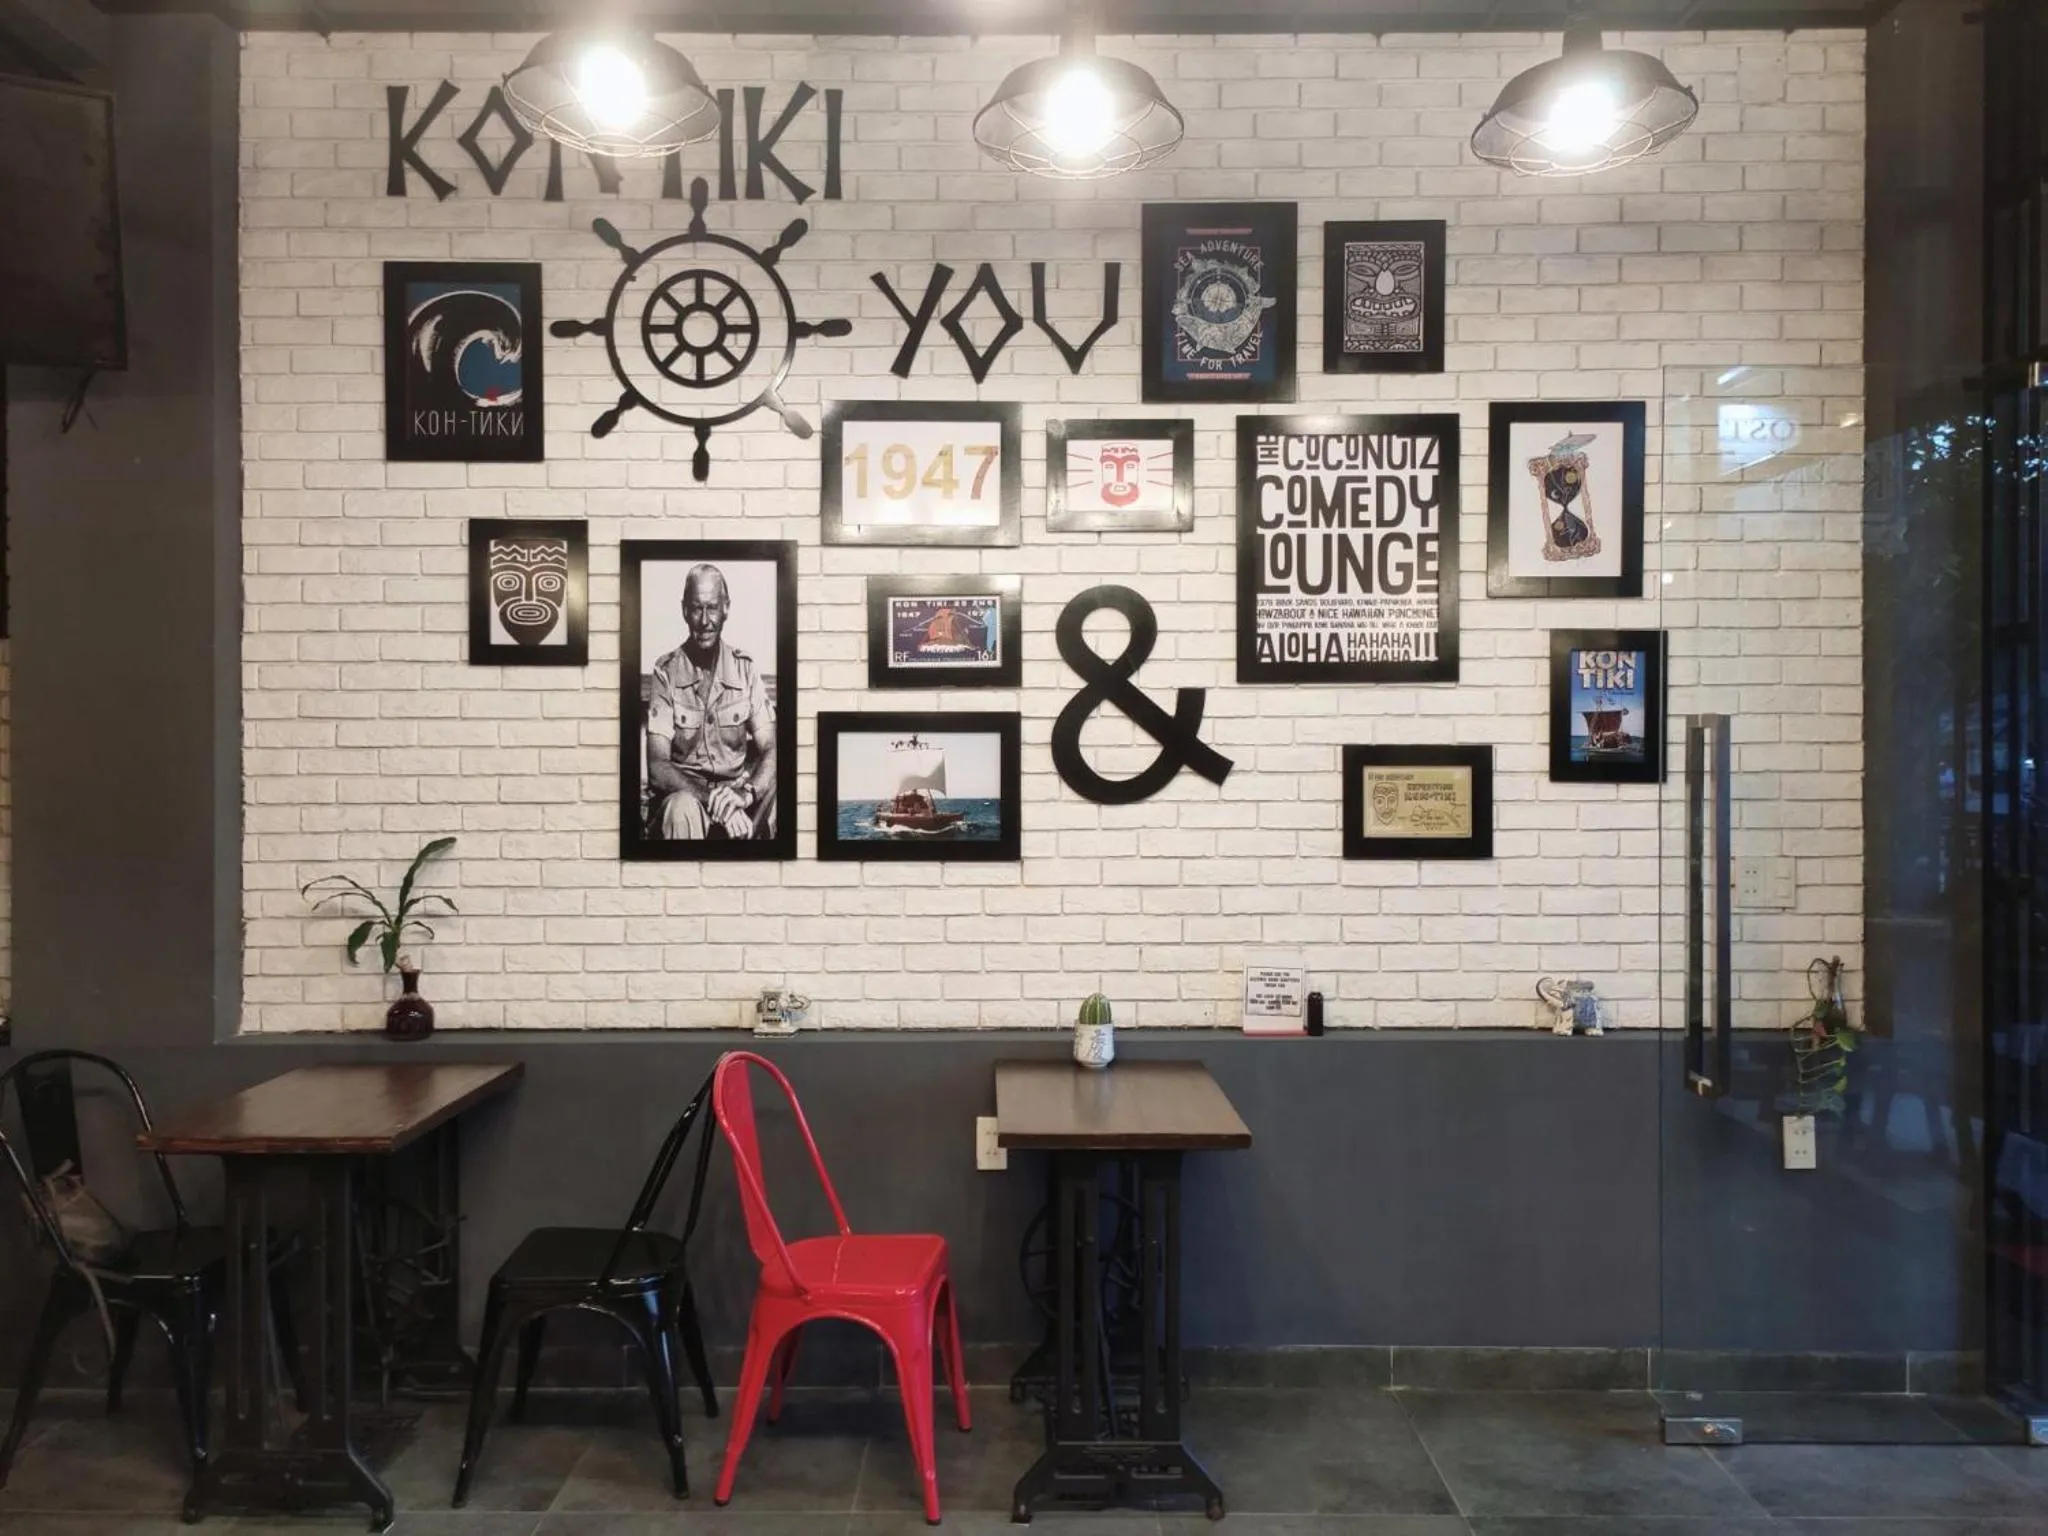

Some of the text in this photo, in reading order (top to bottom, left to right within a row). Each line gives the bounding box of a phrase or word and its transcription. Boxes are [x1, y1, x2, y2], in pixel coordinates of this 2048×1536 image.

[1174, 239, 1265, 272] SEA ADVENTURE
[870, 262, 1121, 385] YOU
[1175, 330, 1264, 371] TIME FOR TRAVEL
[414, 410, 524, 436] КОН-ТИКИ
[844, 442, 999, 500] 1947
[1257, 475, 1439, 529] COMEDY
[1257, 532, 1439, 595] LOUNGE
[1318, 608, 1338, 619] NICE
[895, 651, 909, 662] RF
[1347, 632, 1412, 649] HAHAHA
[1579, 650, 1636, 669] KON
[1051, 584, 1234, 805] &
[1577, 668, 1634, 689] TIKI
